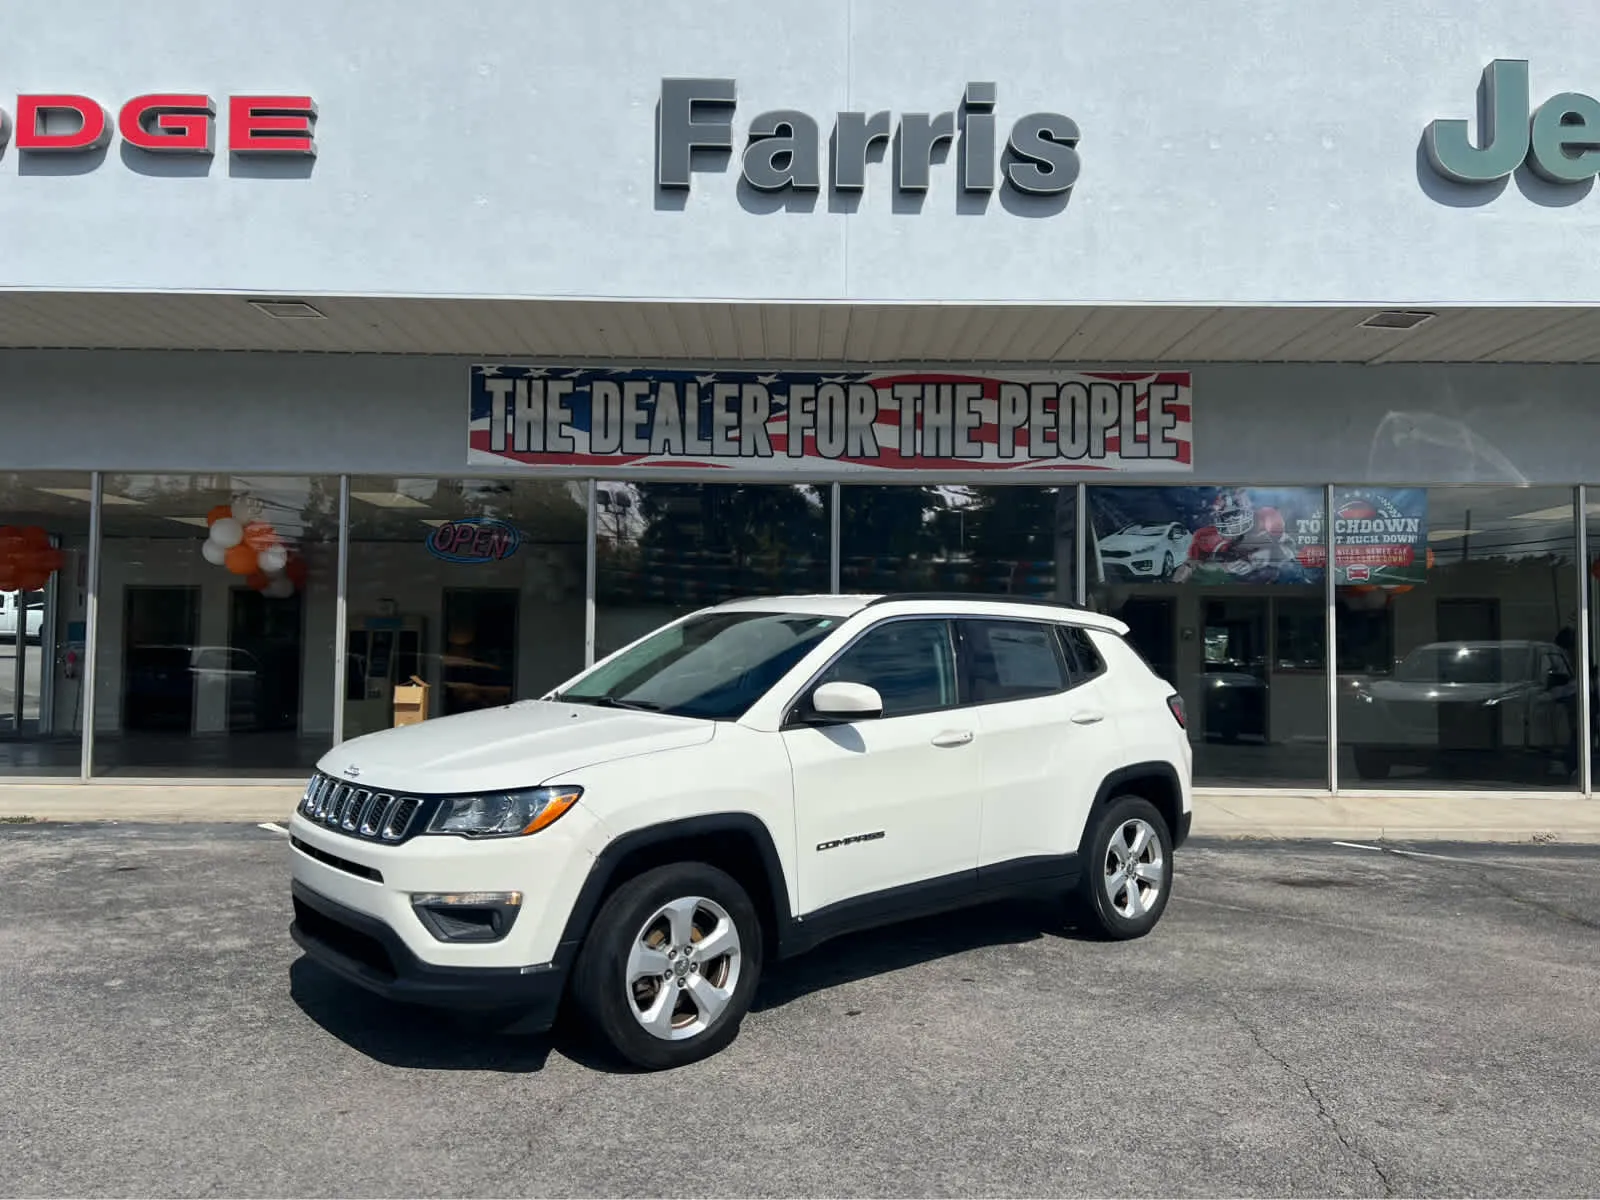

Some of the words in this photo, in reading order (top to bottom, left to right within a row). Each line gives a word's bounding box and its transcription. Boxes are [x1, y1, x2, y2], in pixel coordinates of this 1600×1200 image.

[0, 93, 317, 156] DGE
[658, 77, 1082, 195] Farris
[483, 376, 576, 453] THE
[589, 380, 774, 457] DEALER
[787, 382, 881, 459] FOR
[891, 382, 984, 458] THE
[997, 381, 1179, 460] PEOPLE
[433, 522, 510, 559] OPEN
[1296, 519, 1420, 534] TOCHDOWN
[1297, 535, 1319, 545] FOR
[1346, 535, 1379, 545] MUCH
[816, 830, 886, 851] COMPASS
